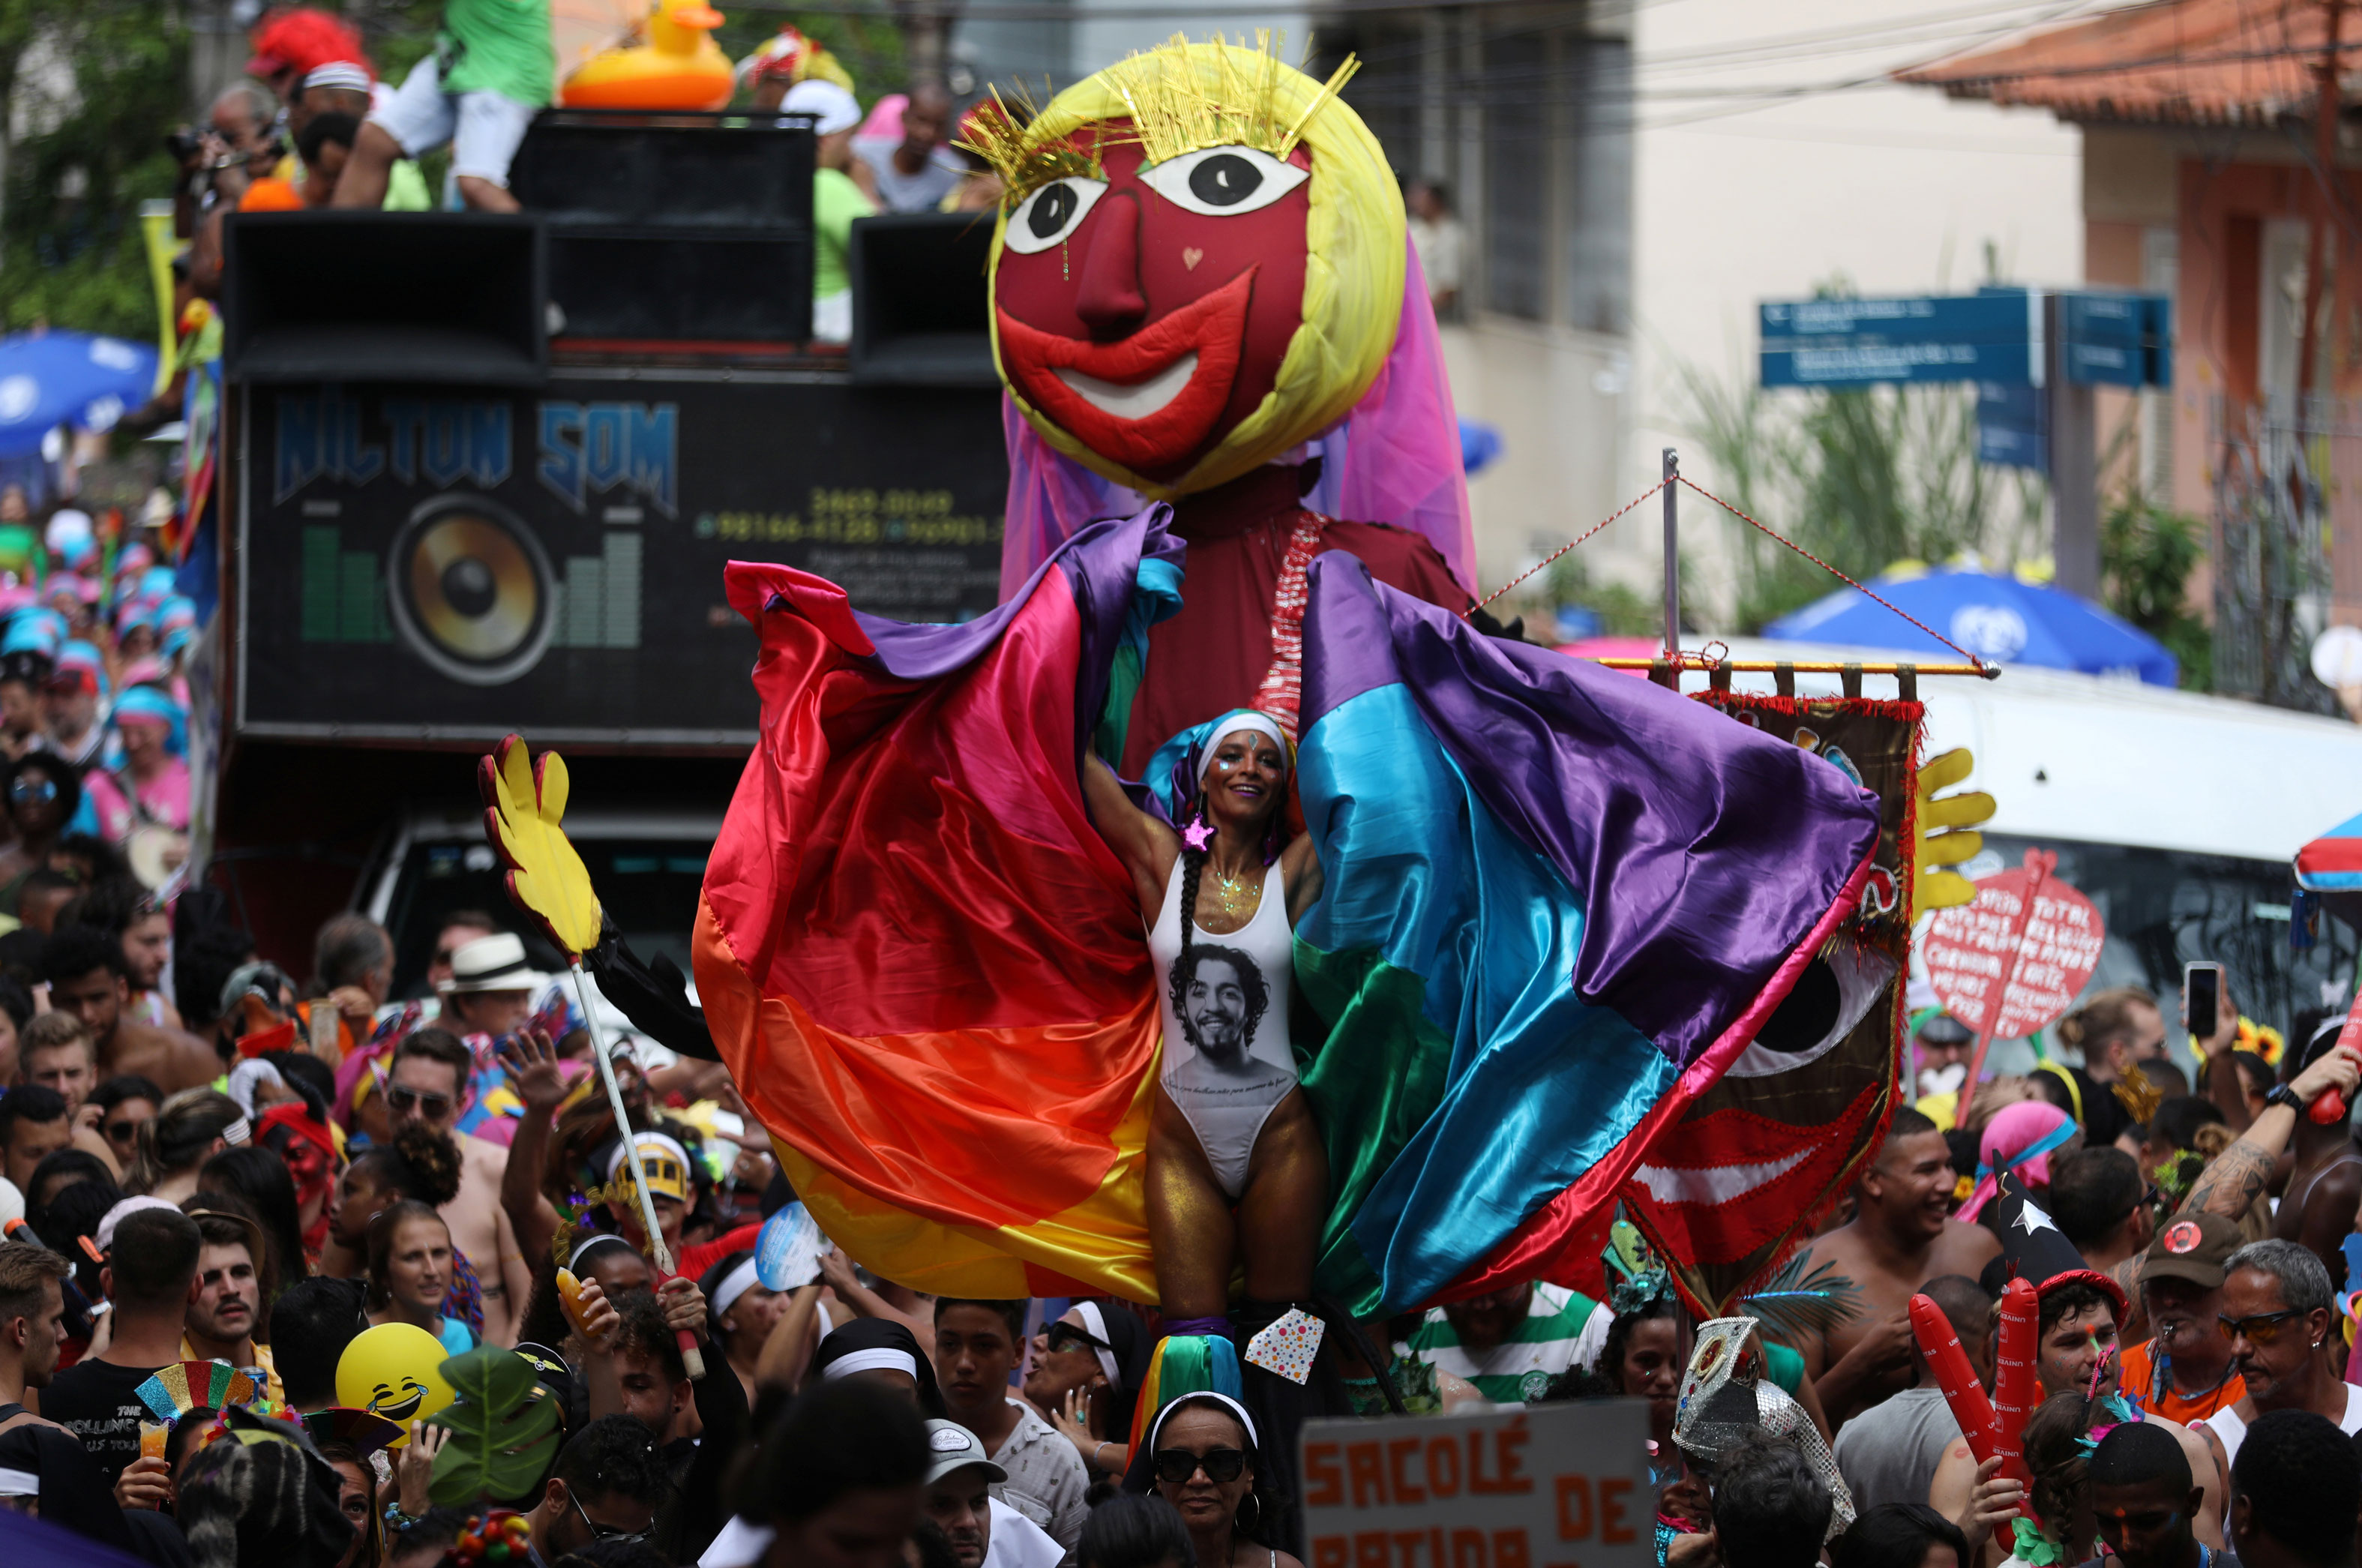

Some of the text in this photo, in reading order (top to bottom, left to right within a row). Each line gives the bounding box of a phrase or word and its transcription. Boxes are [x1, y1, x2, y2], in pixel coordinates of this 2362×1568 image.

[273, 394, 680, 519] NILTON SOM
[2042, 943, 2097, 972] AMOR
[116, 1405, 142, 1417] THE
[1302, 1413, 1534, 1507] SACOLÉ
[1554, 1474, 1639, 1546] DE
